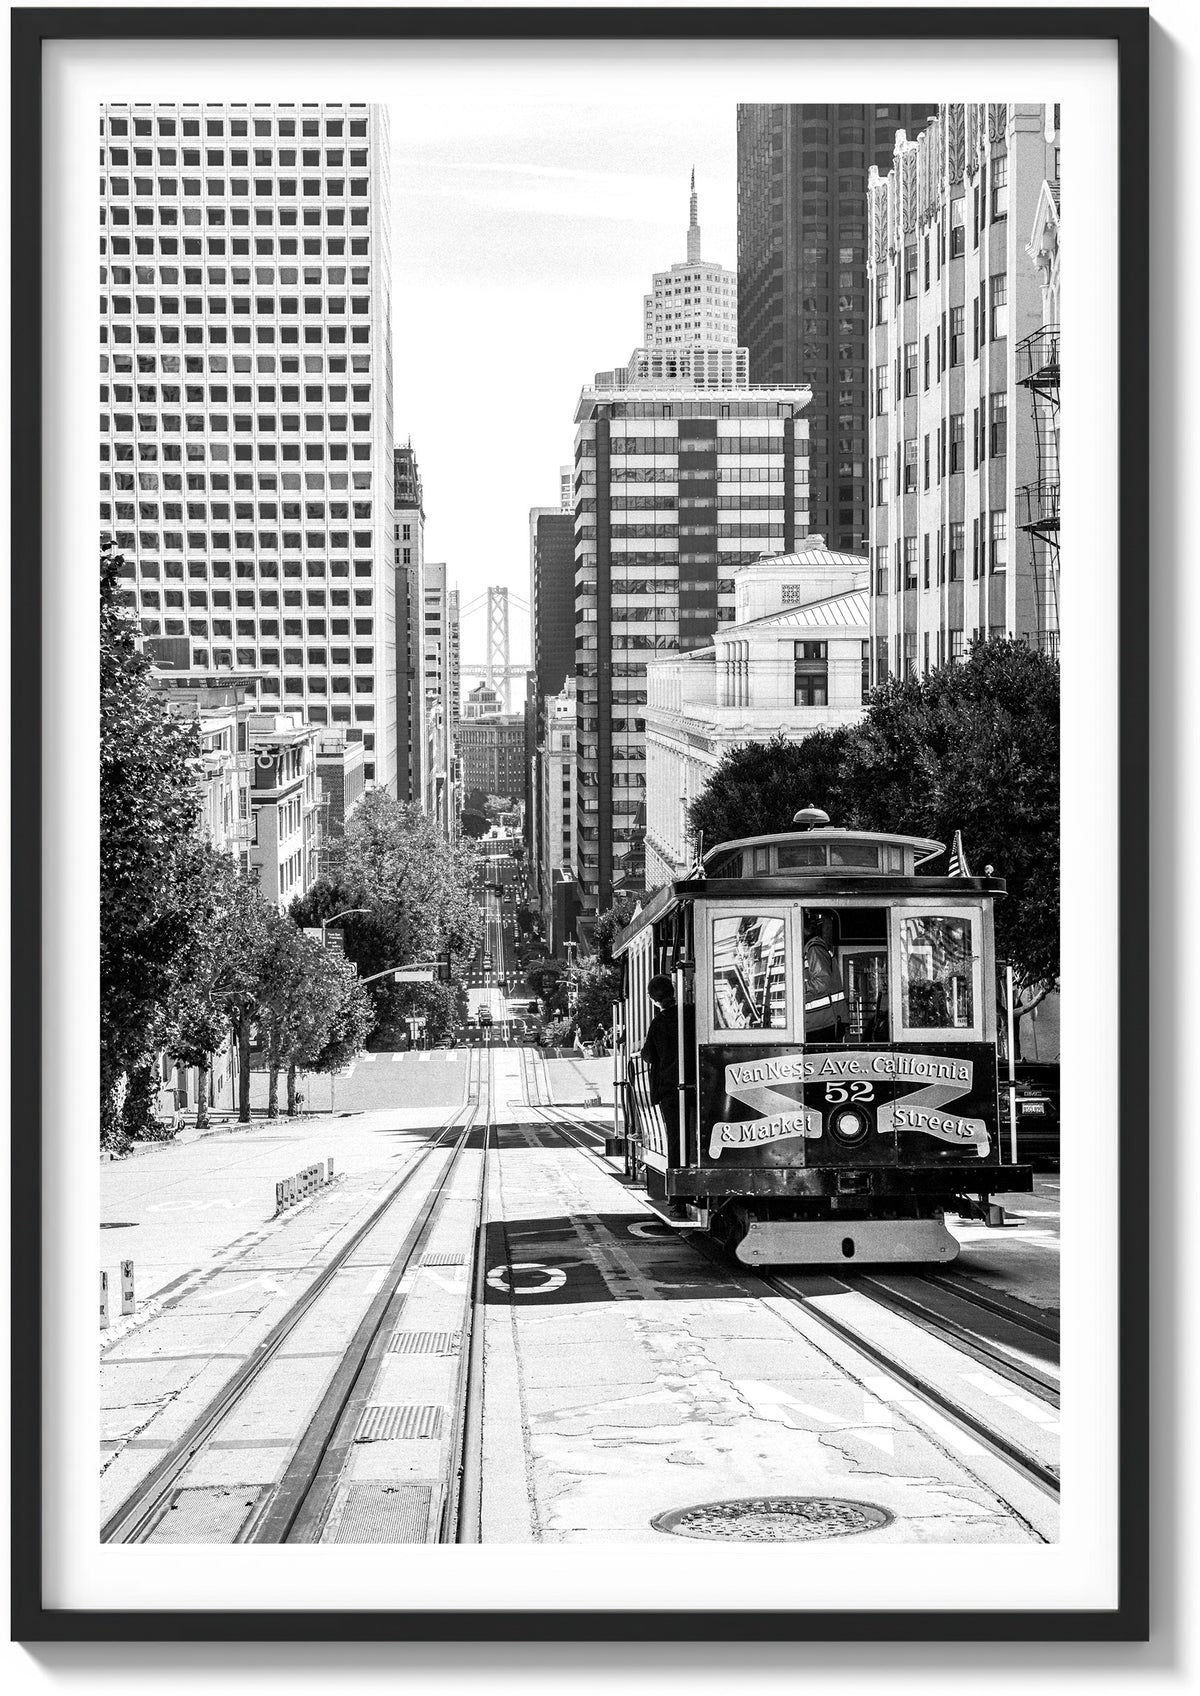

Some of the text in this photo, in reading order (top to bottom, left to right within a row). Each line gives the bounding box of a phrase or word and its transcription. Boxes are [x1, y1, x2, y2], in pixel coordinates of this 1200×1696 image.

[729, 1065, 765, 1084] Van
[765, 1061, 815, 1081] Ness
[872, 1056, 970, 1081] California
[824, 1080, 875, 1103] 52
[720, 1109, 975, 1142] & Market Streets
